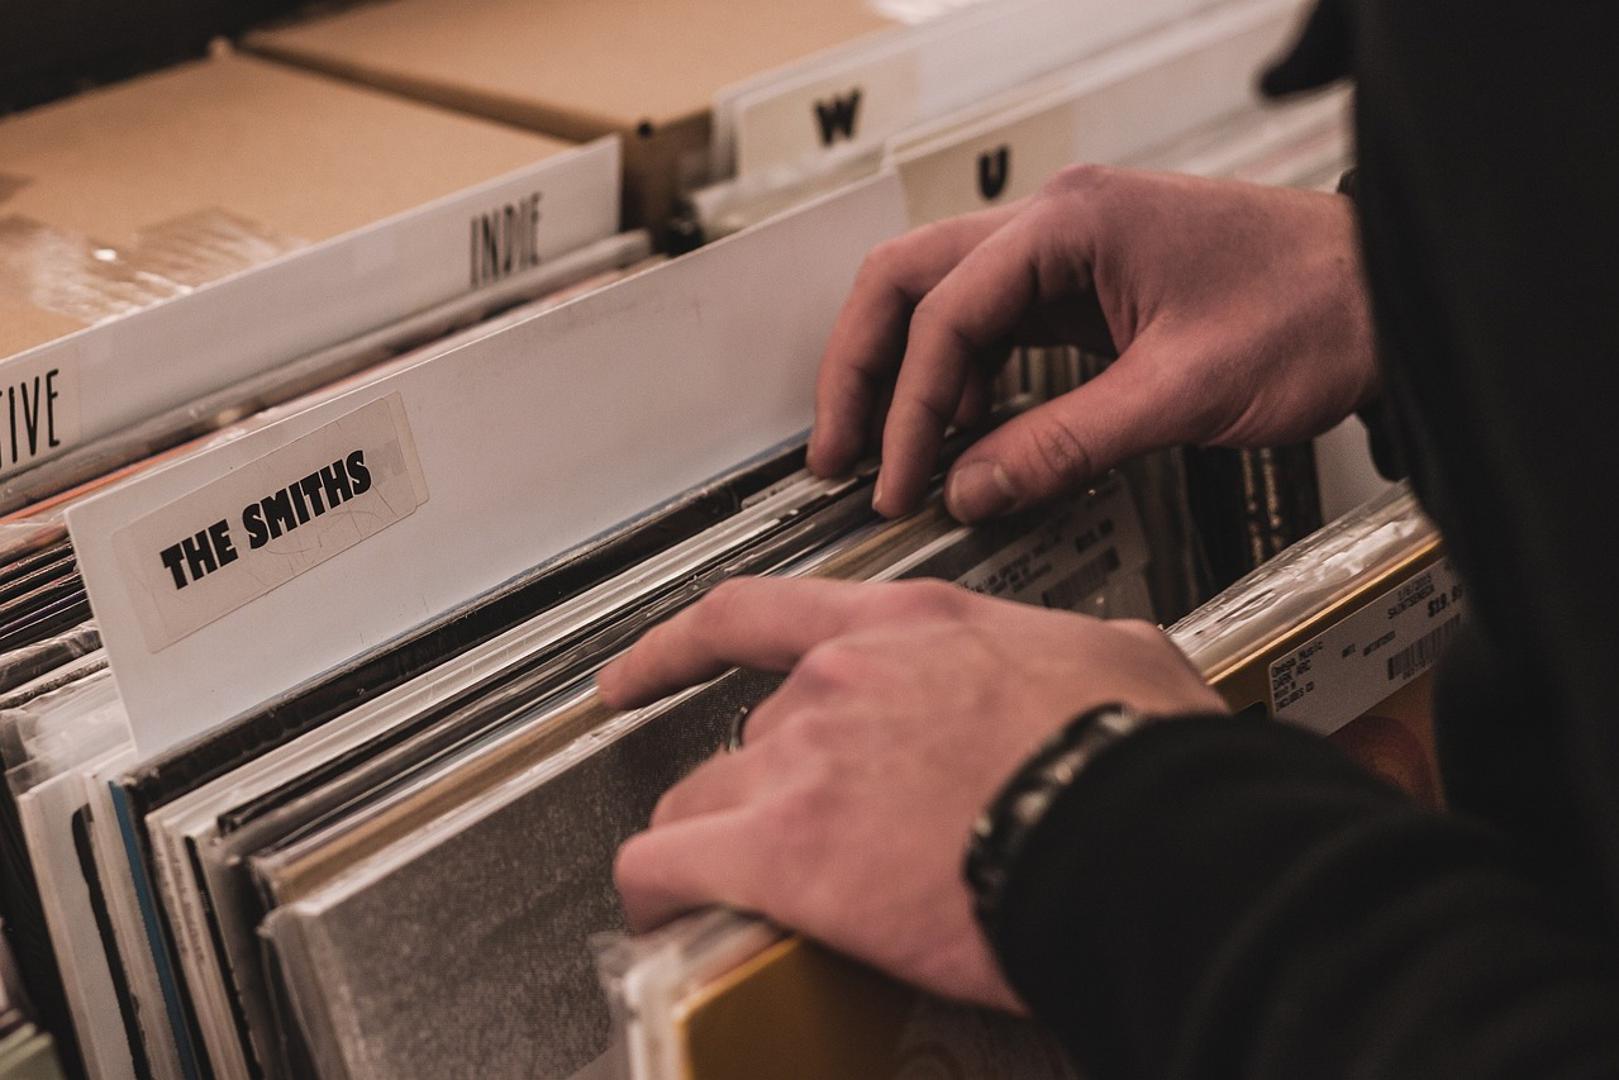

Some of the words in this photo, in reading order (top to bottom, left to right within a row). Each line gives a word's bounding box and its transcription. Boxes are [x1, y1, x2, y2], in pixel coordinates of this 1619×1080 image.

[814, 87, 863, 147] W
[977, 144, 1010, 203] U
[469, 192, 543, 289] INDIE
[0, 368, 61, 468] IVE
[160, 518, 239, 591] THE
[242, 449, 372, 550] SMITHS
